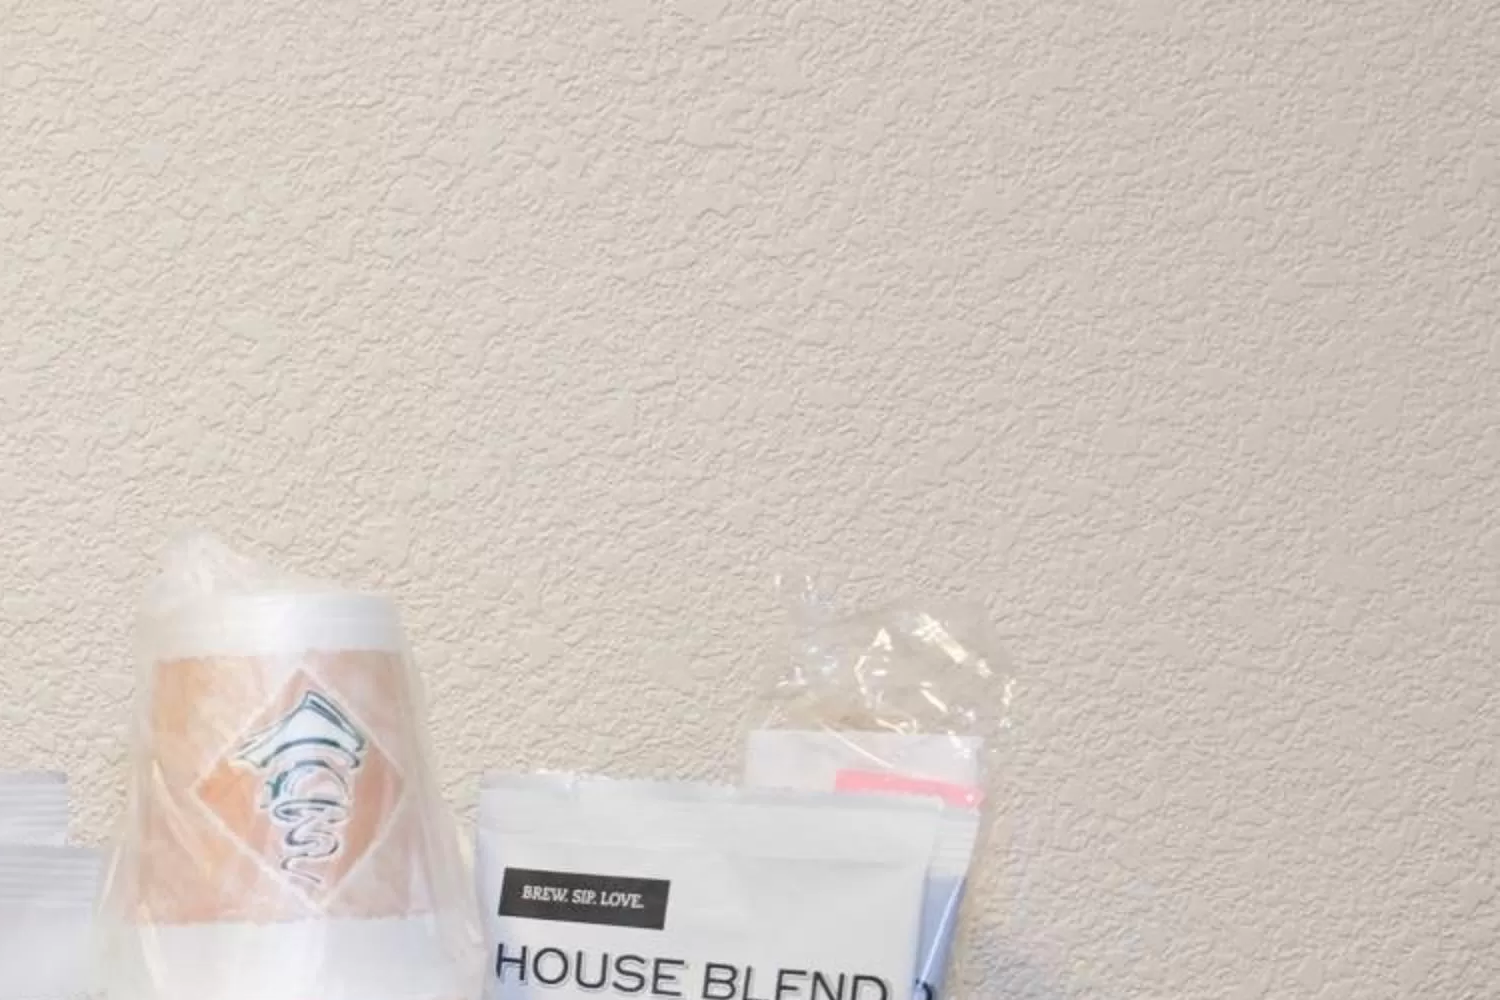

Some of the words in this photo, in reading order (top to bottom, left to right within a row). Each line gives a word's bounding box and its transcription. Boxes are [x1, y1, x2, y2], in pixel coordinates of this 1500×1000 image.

[521, 884, 568, 903] BREW.
[571, 888, 597, 905] SIP.
[600, 891, 645, 909] LOVE.
[495, 942, 686, 998] HOUSE
